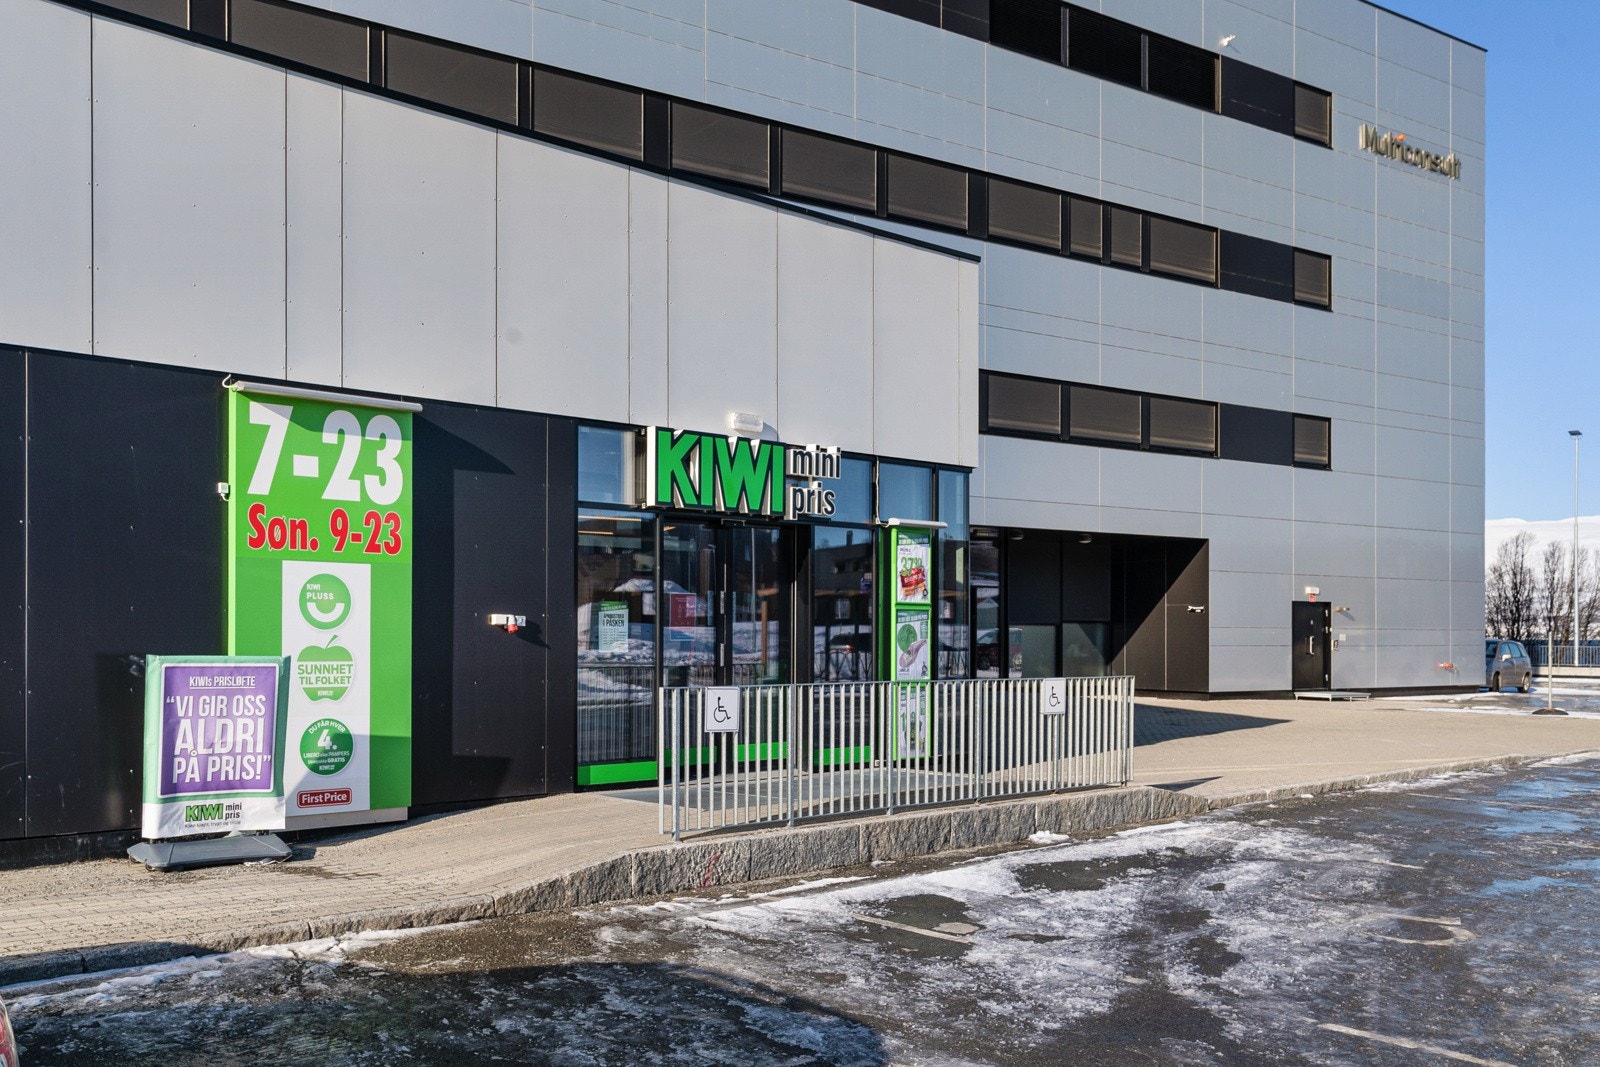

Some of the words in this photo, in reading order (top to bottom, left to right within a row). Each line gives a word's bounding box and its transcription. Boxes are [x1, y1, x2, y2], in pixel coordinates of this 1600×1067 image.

[247, 401, 404, 506] 7-23
[788, 443, 841, 479] mini
[648, 426, 786, 515] KIWI
[787, 481, 836, 520] pris
[247, 502, 319, 552] Søn.
[329, 507, 403, 556] 9-23
[306, 583, 321, 591] KIWI
[306, 592, 335, 600] PLUSS
[297, 663, 354, 675] SUNNHET
[189, 676, 213, 687] KIWIs
[213, 675, 256, 687] PRISLØFTE
[299, 676, 314, 685] TIL
[315, 675, 352, 685] FOLKET
[198, 695, 228, 717] GIR
[232, 694, 266, 717] OSS
[174, 717, 265, 756] ALDRI
[308, 724, 318, 735] DU
[317, 720, 330, 728] FÅR
[329, 720, 346, 733] HVER
[317, 728, 338, 750] 4.
[172, 749, 201, 784] PÅ
[225, 802, 242, 811] mini
[301, 793, 323, 804] First
[324, 791, 347, 802] Price
[185, 803, 224, 822] KIWI
[225, 811, 241, 820] pris
